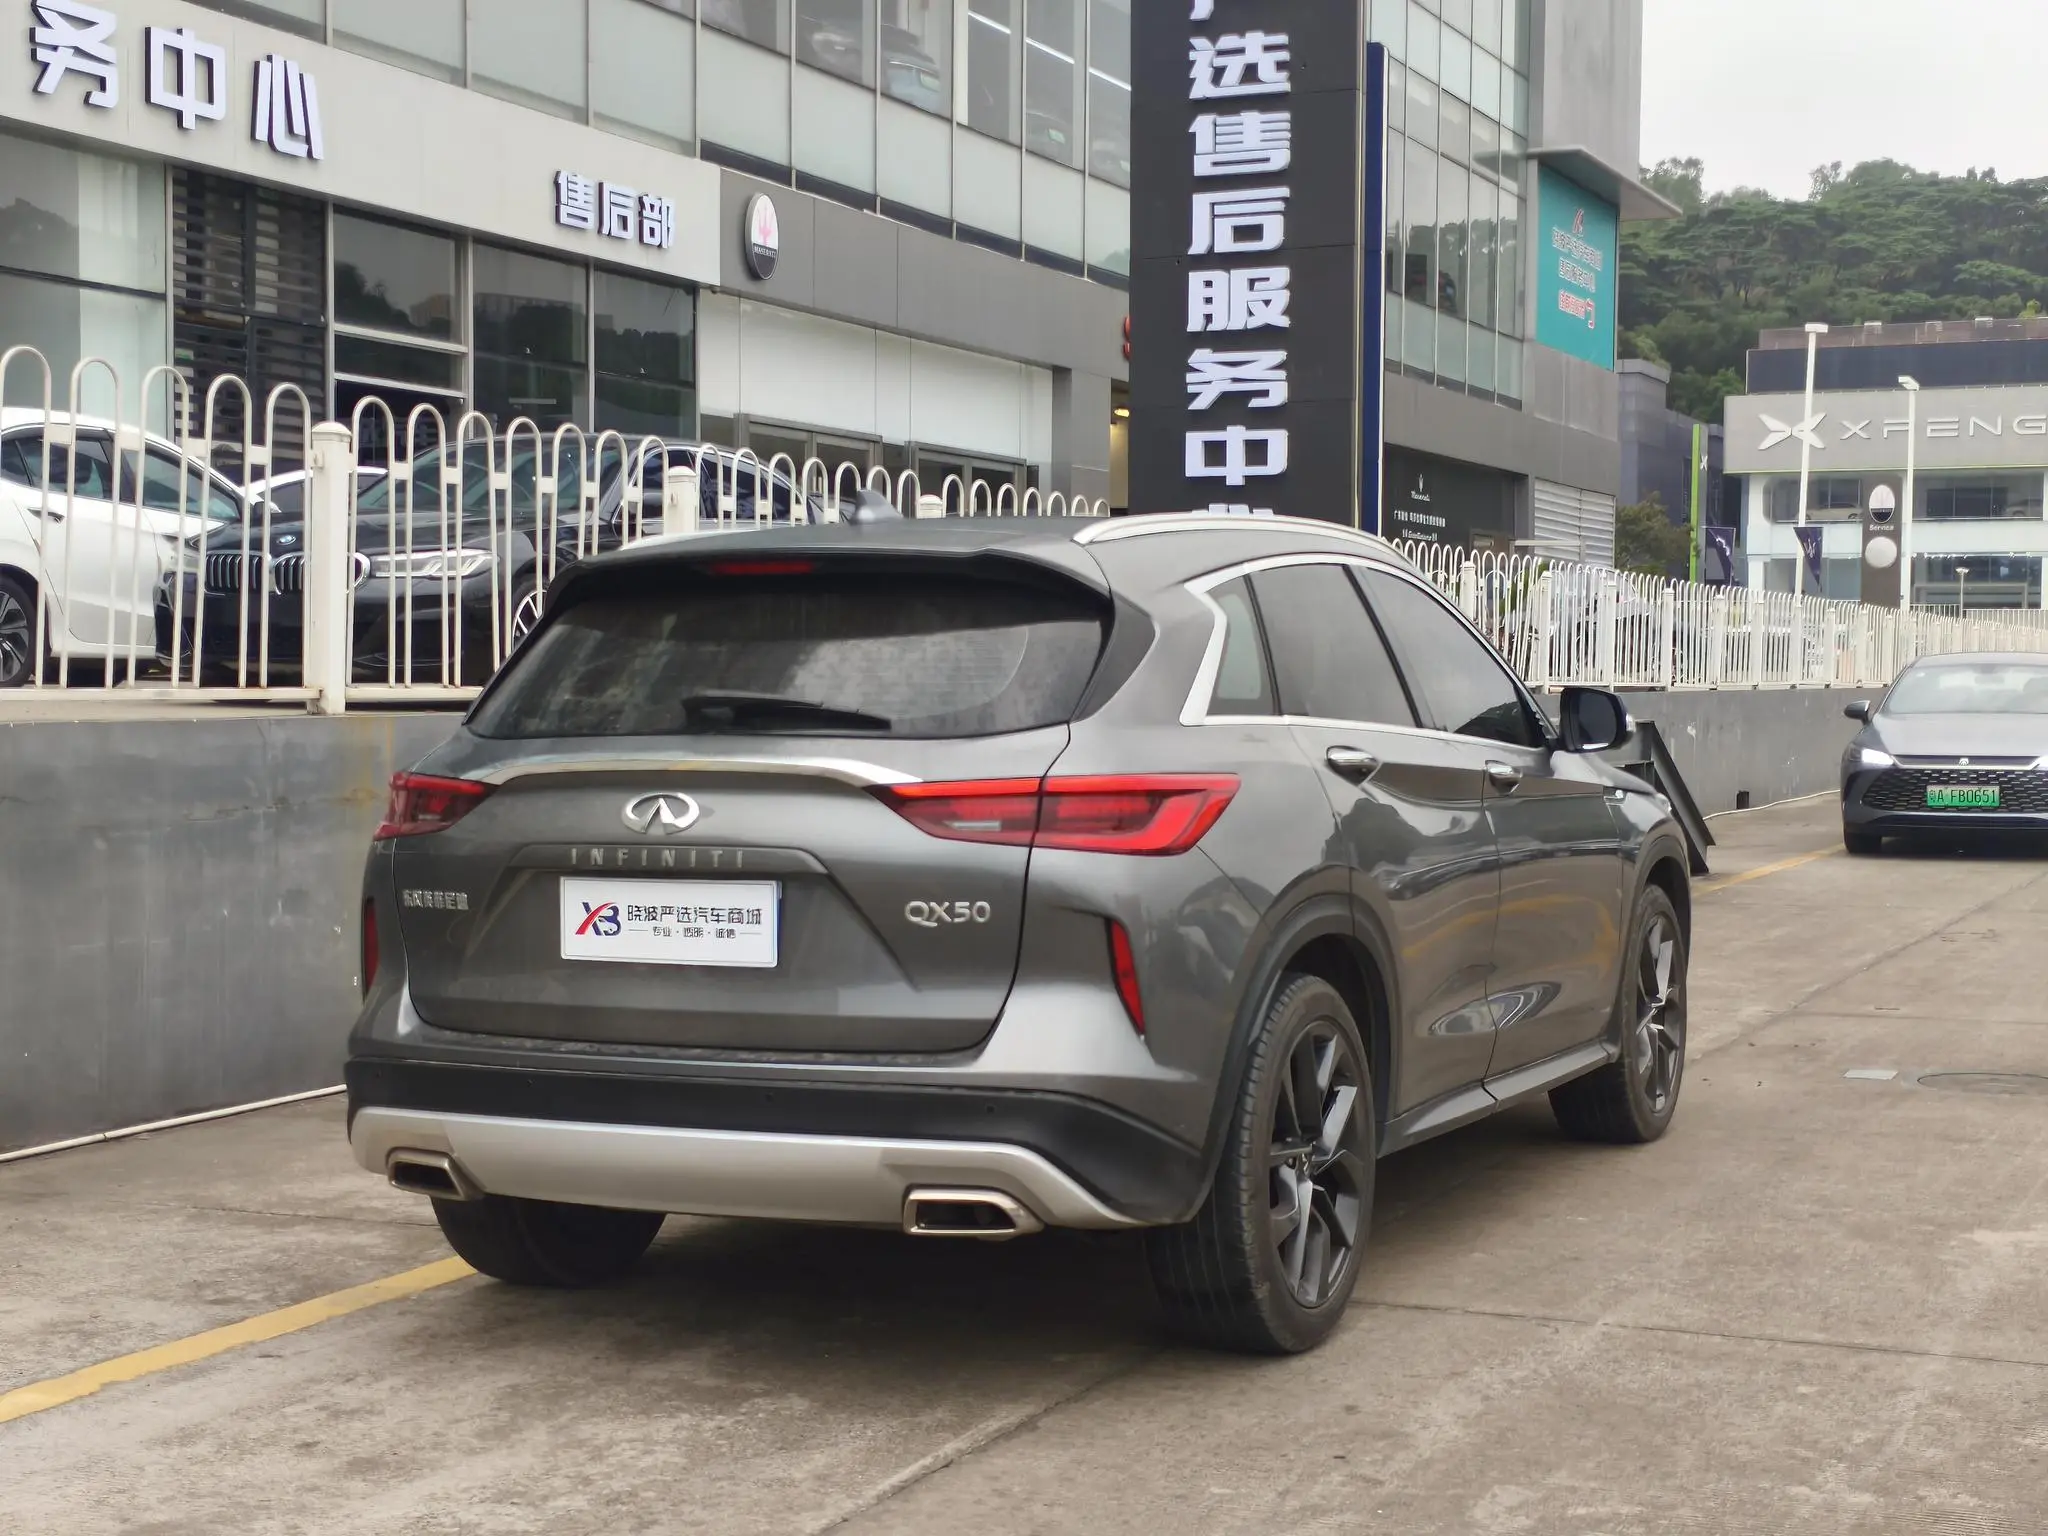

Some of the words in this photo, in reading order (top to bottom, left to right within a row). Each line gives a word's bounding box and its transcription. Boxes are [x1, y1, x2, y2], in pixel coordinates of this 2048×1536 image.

[28, 0, 325, 161] 务中心
[554, 170, 676, 249] 售后部
[1185, 0, 1292, 516] 选售后服务中
[569, 847, 744, 869] INFINITI
[627, 904, 763, 926] 晓波严选汽车商城
[904, 900, 991, 928] QX50
